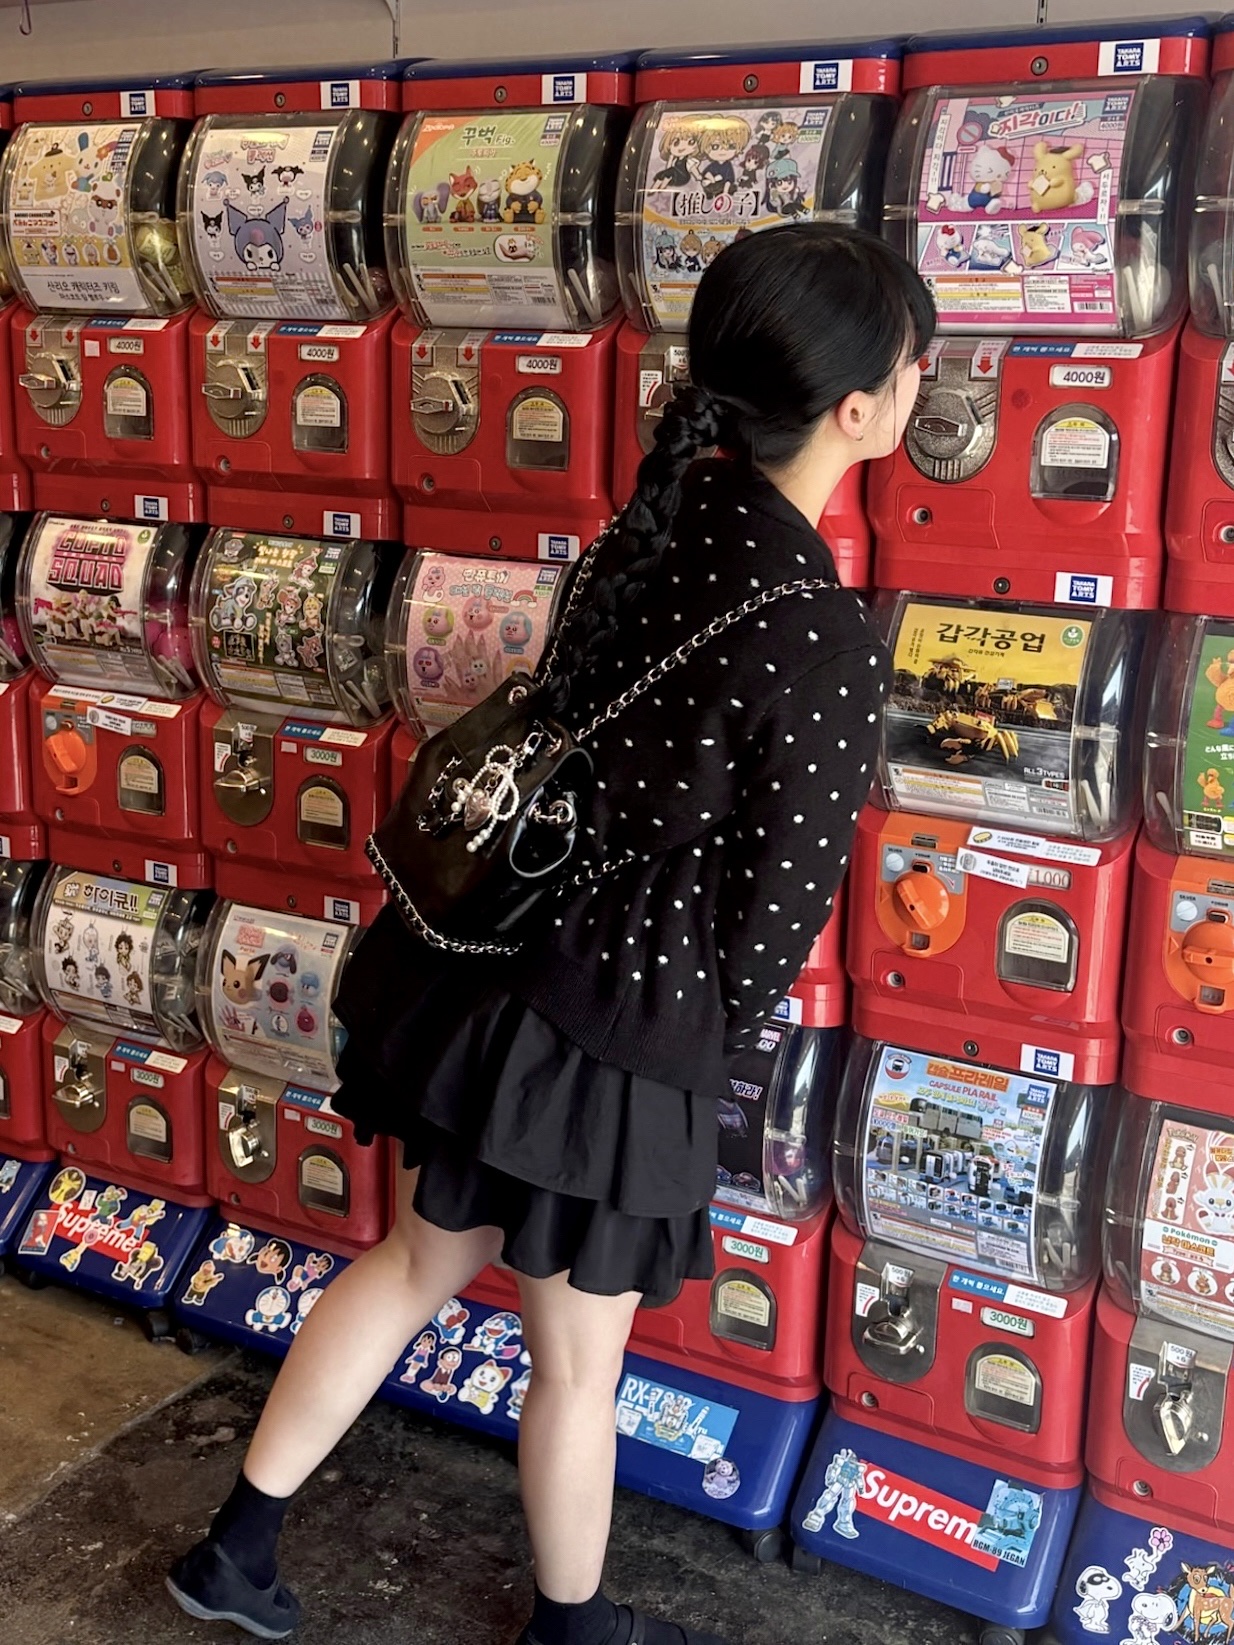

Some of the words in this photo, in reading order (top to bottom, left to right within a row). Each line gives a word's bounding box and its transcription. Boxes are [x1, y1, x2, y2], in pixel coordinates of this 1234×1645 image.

[999, 102, 1080, 135] 지각이다!
[496, 134, 515, 145] Fig.
[47, 281, 71, 293] 산리오
[102, 282, 120, 294] 키링
[116, 340, 141, 351] 4000원
[306, 348, 335, 359] 4000원
[526, 359, 557, 371] 4000원
[1063, 370, 1105, 384] 4000원
[46, 557, 124, 591] SQUAD
[1071, 585, 1093, 593] TOMY
[1071, 591, 1092, 599] ARTS
[936, 623, 1046, 653] 갑각공업
[310, 749, 338, 763] 3000원
[83, 884, 139, 913] 하이큐!!
[1036, 1053, 1057, 1061] TAKARA
[1036, 1058, 1056, 1066] TOMY
[1035, 1063, 1056, 1071] ARTS
[136, 1069, 160, 1085] 3000원
[927, 1060, 1009, 1093] 캡슐프라레일
[929, 1080, 962, 1094] CAPSULE
[311, 1119, 338, 1135] 3000원
[1170, 1227, 1211, 1245] Pokémon
[730, 1240, 764, 1259] 3000원
[1180, 1239, 1215, 1257] 마스코트
[952, 1275, 960, 1283] 한
[989, 1310, 1029, 1331] 3000원
[859, 1470, 979, 1544] Suprem
[972, 1539, 1001, 1557] RGM-89
[1001, 1550, 1025, 1566] JEGAN
